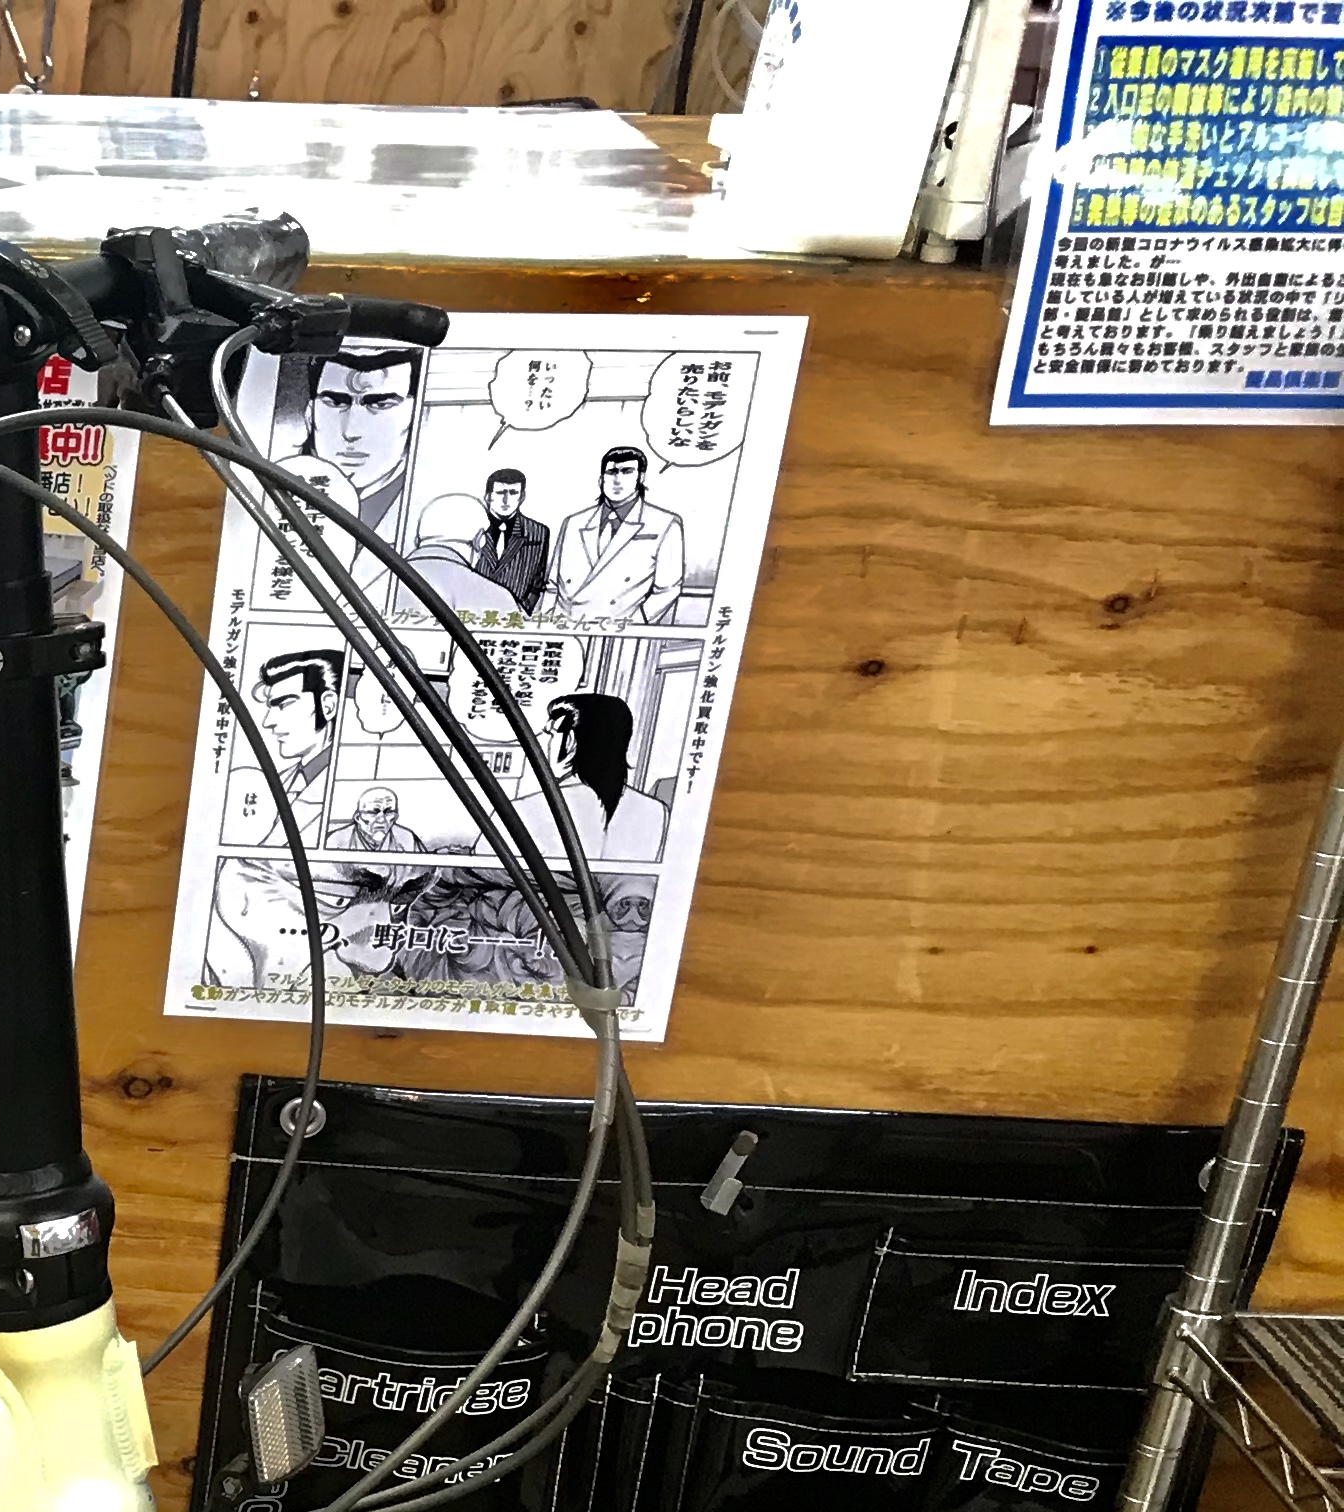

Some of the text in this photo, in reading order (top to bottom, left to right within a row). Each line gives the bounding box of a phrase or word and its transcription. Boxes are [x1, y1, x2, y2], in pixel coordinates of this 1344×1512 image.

[539, 362, 557, 410] いったい
[668, 363, 704, 447] 売りたいらしいな
[695, 360, 732, 451] お前、モデルガンを
[539, 640, 565, 684] 買取担当の
[686, 606, 733, 794] モデルガン強化買取中です!
[243, 793, 258, 818] はい
[647, 1264, 800, 1311] Head
[953, 1268, 1117, 1319] Index
[627, 1307, 804, 1354] phone
[312, 1366, 531, 1416] artridge
[741, 1426, 1102, 1502] Sound Tape
